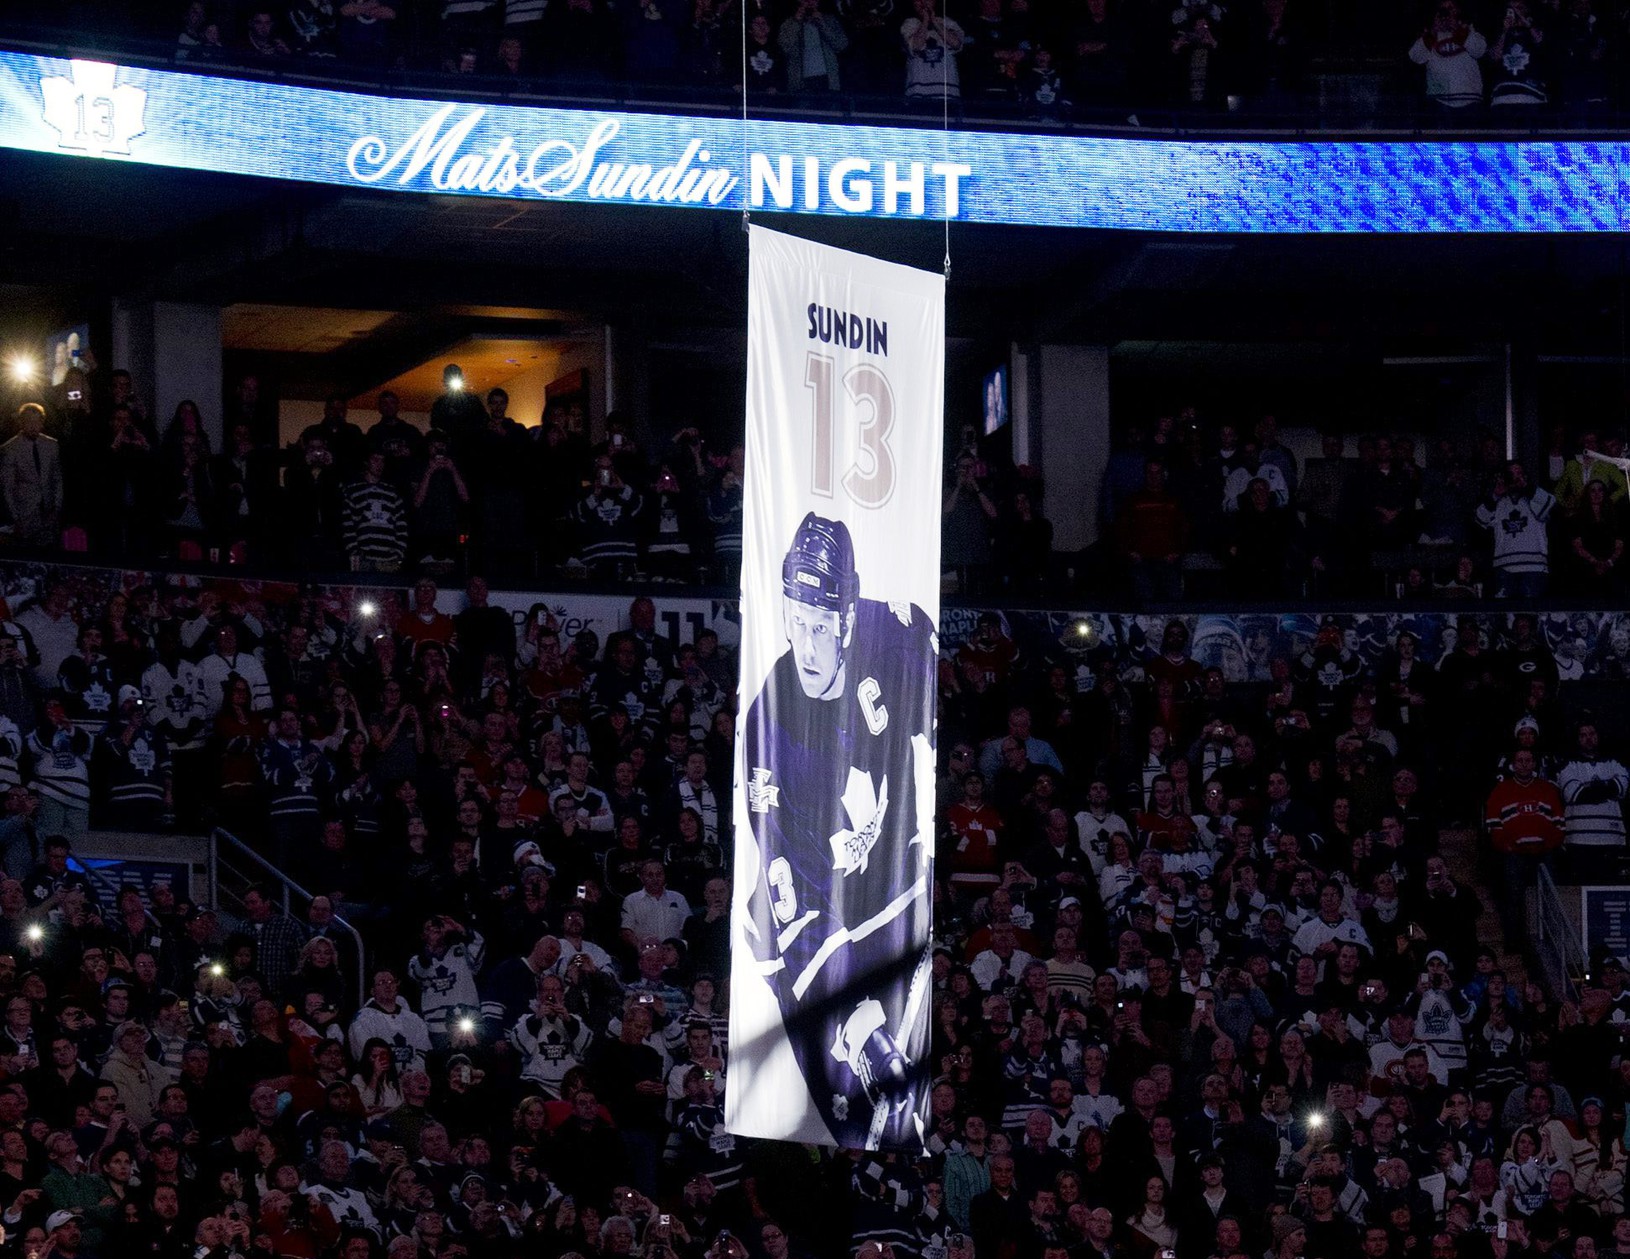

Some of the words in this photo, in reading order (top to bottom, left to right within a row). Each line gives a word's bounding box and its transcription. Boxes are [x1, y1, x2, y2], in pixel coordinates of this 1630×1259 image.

[73, 93, 115, 142] 13
[346, 102, 520, 193] Mats
[518, 118, 738, 206] Sundin
[750, 152, 972, 218] NIGHT
[807, 302, 888, 358] SUNDIN
[804, 350, 898, 511] 13
[798, 573, 820, 586] CCM
[857, 676, 889, 736] C
[768, 856, 797, 923] 3
